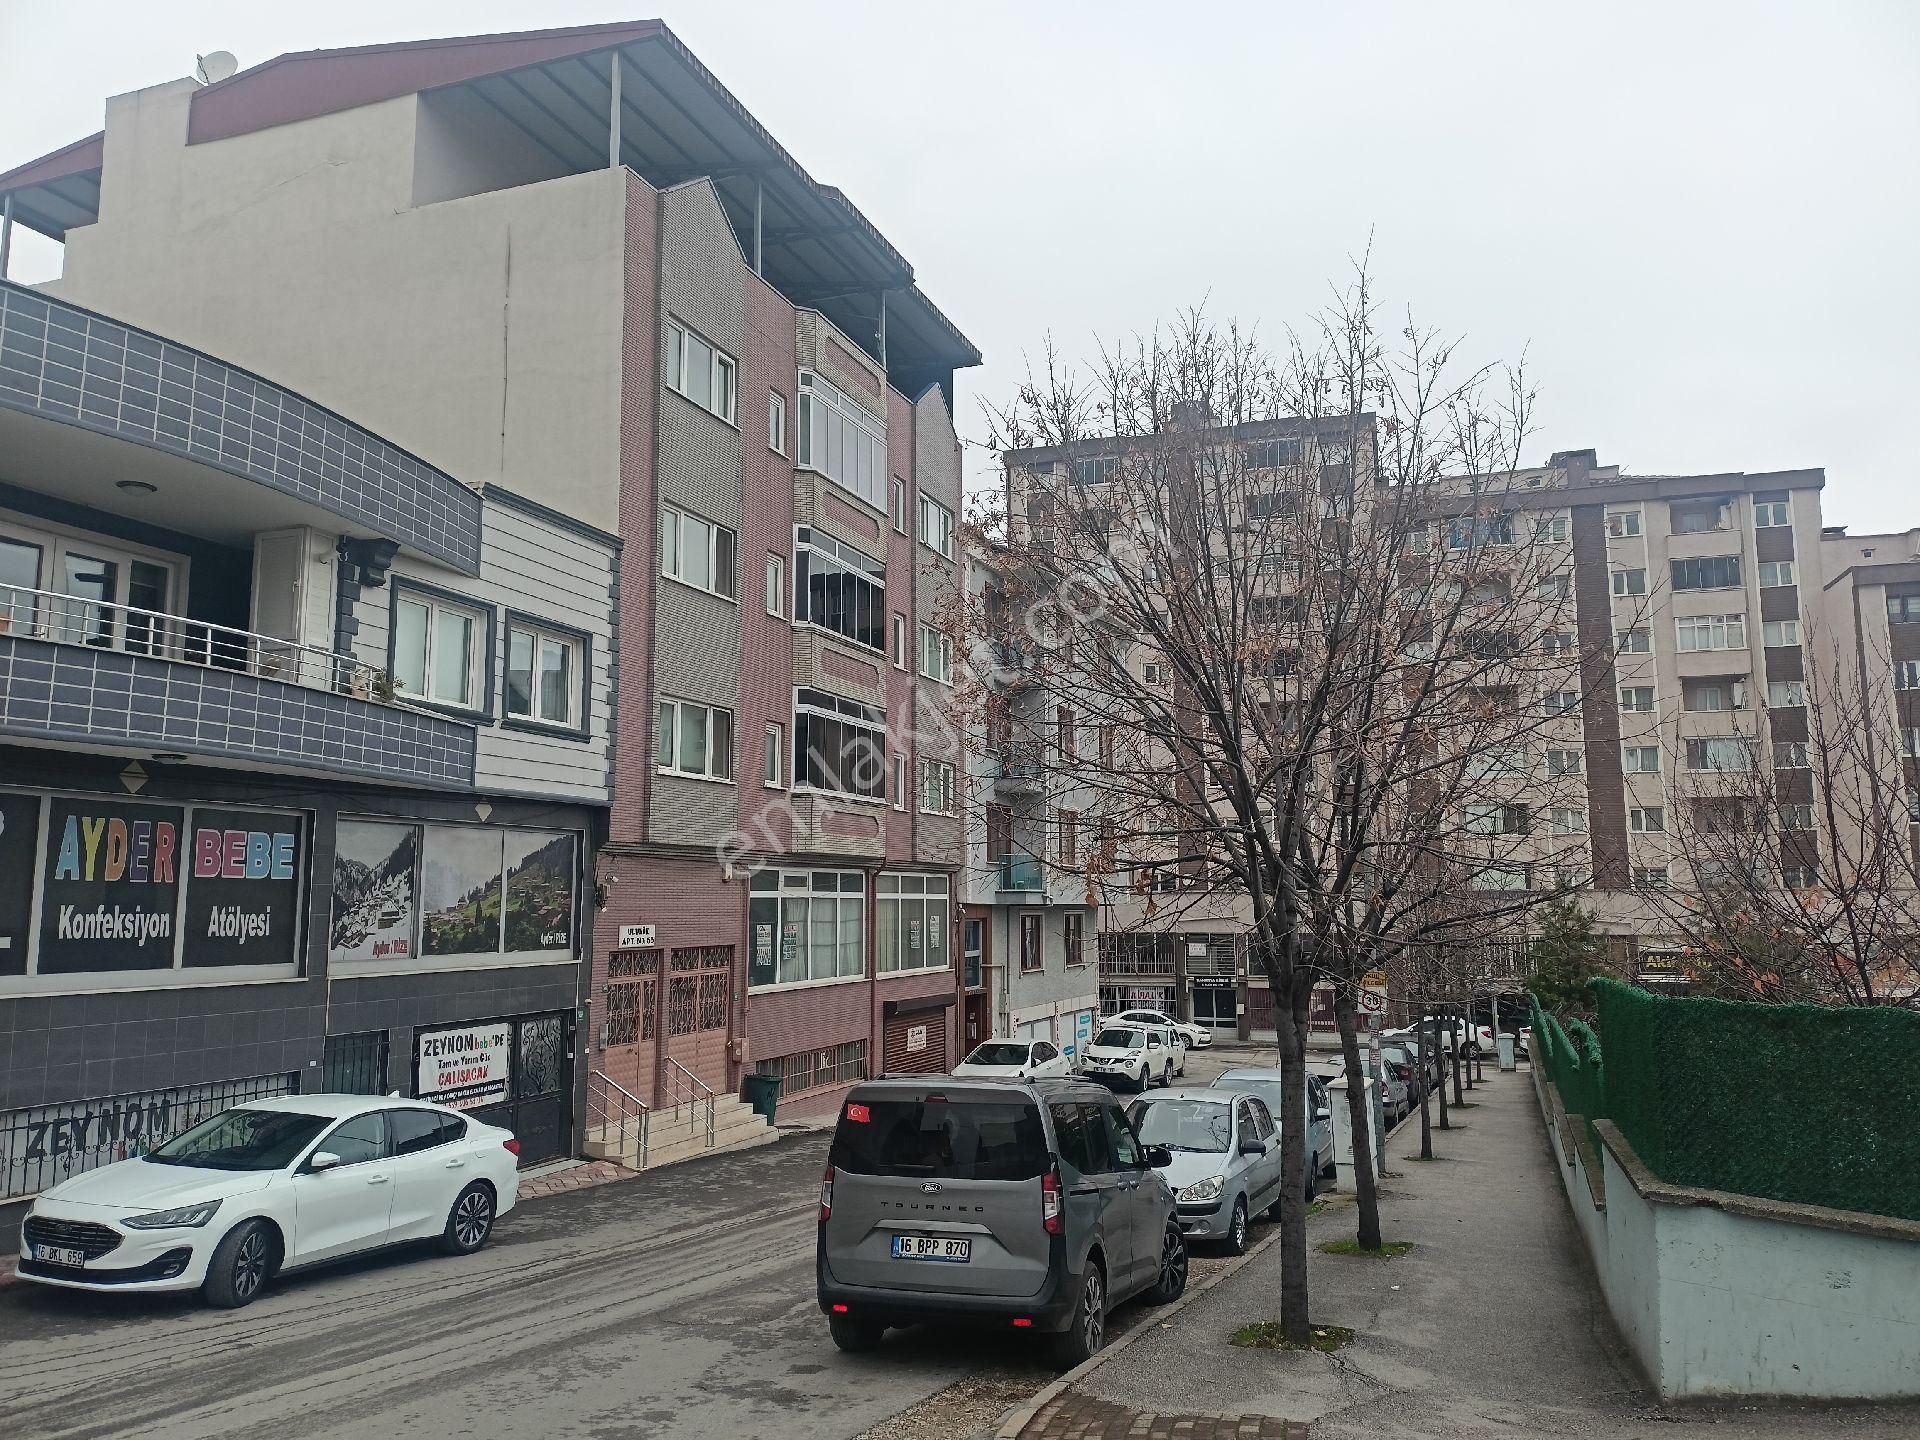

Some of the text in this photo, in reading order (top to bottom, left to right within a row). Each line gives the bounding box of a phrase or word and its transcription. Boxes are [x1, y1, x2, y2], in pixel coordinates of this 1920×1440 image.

[54, 815, 175, 883] AYDER
[194, 828, 295, 880] BEBE
[58, 904, 272, 947] Konfeksiyon Atölyesi
[1365, 996, 1380, 1006] 30
[438, 1059, 452, 1069] Tam
[26, 1099, 171, 1159] ZEYNOM
[880, 1201, 984, 1212] TOURNEO
[38, 1245, 83, 1264] 16 BKL 659
[900, 1238, 967, 1256] 16 BPP 870
